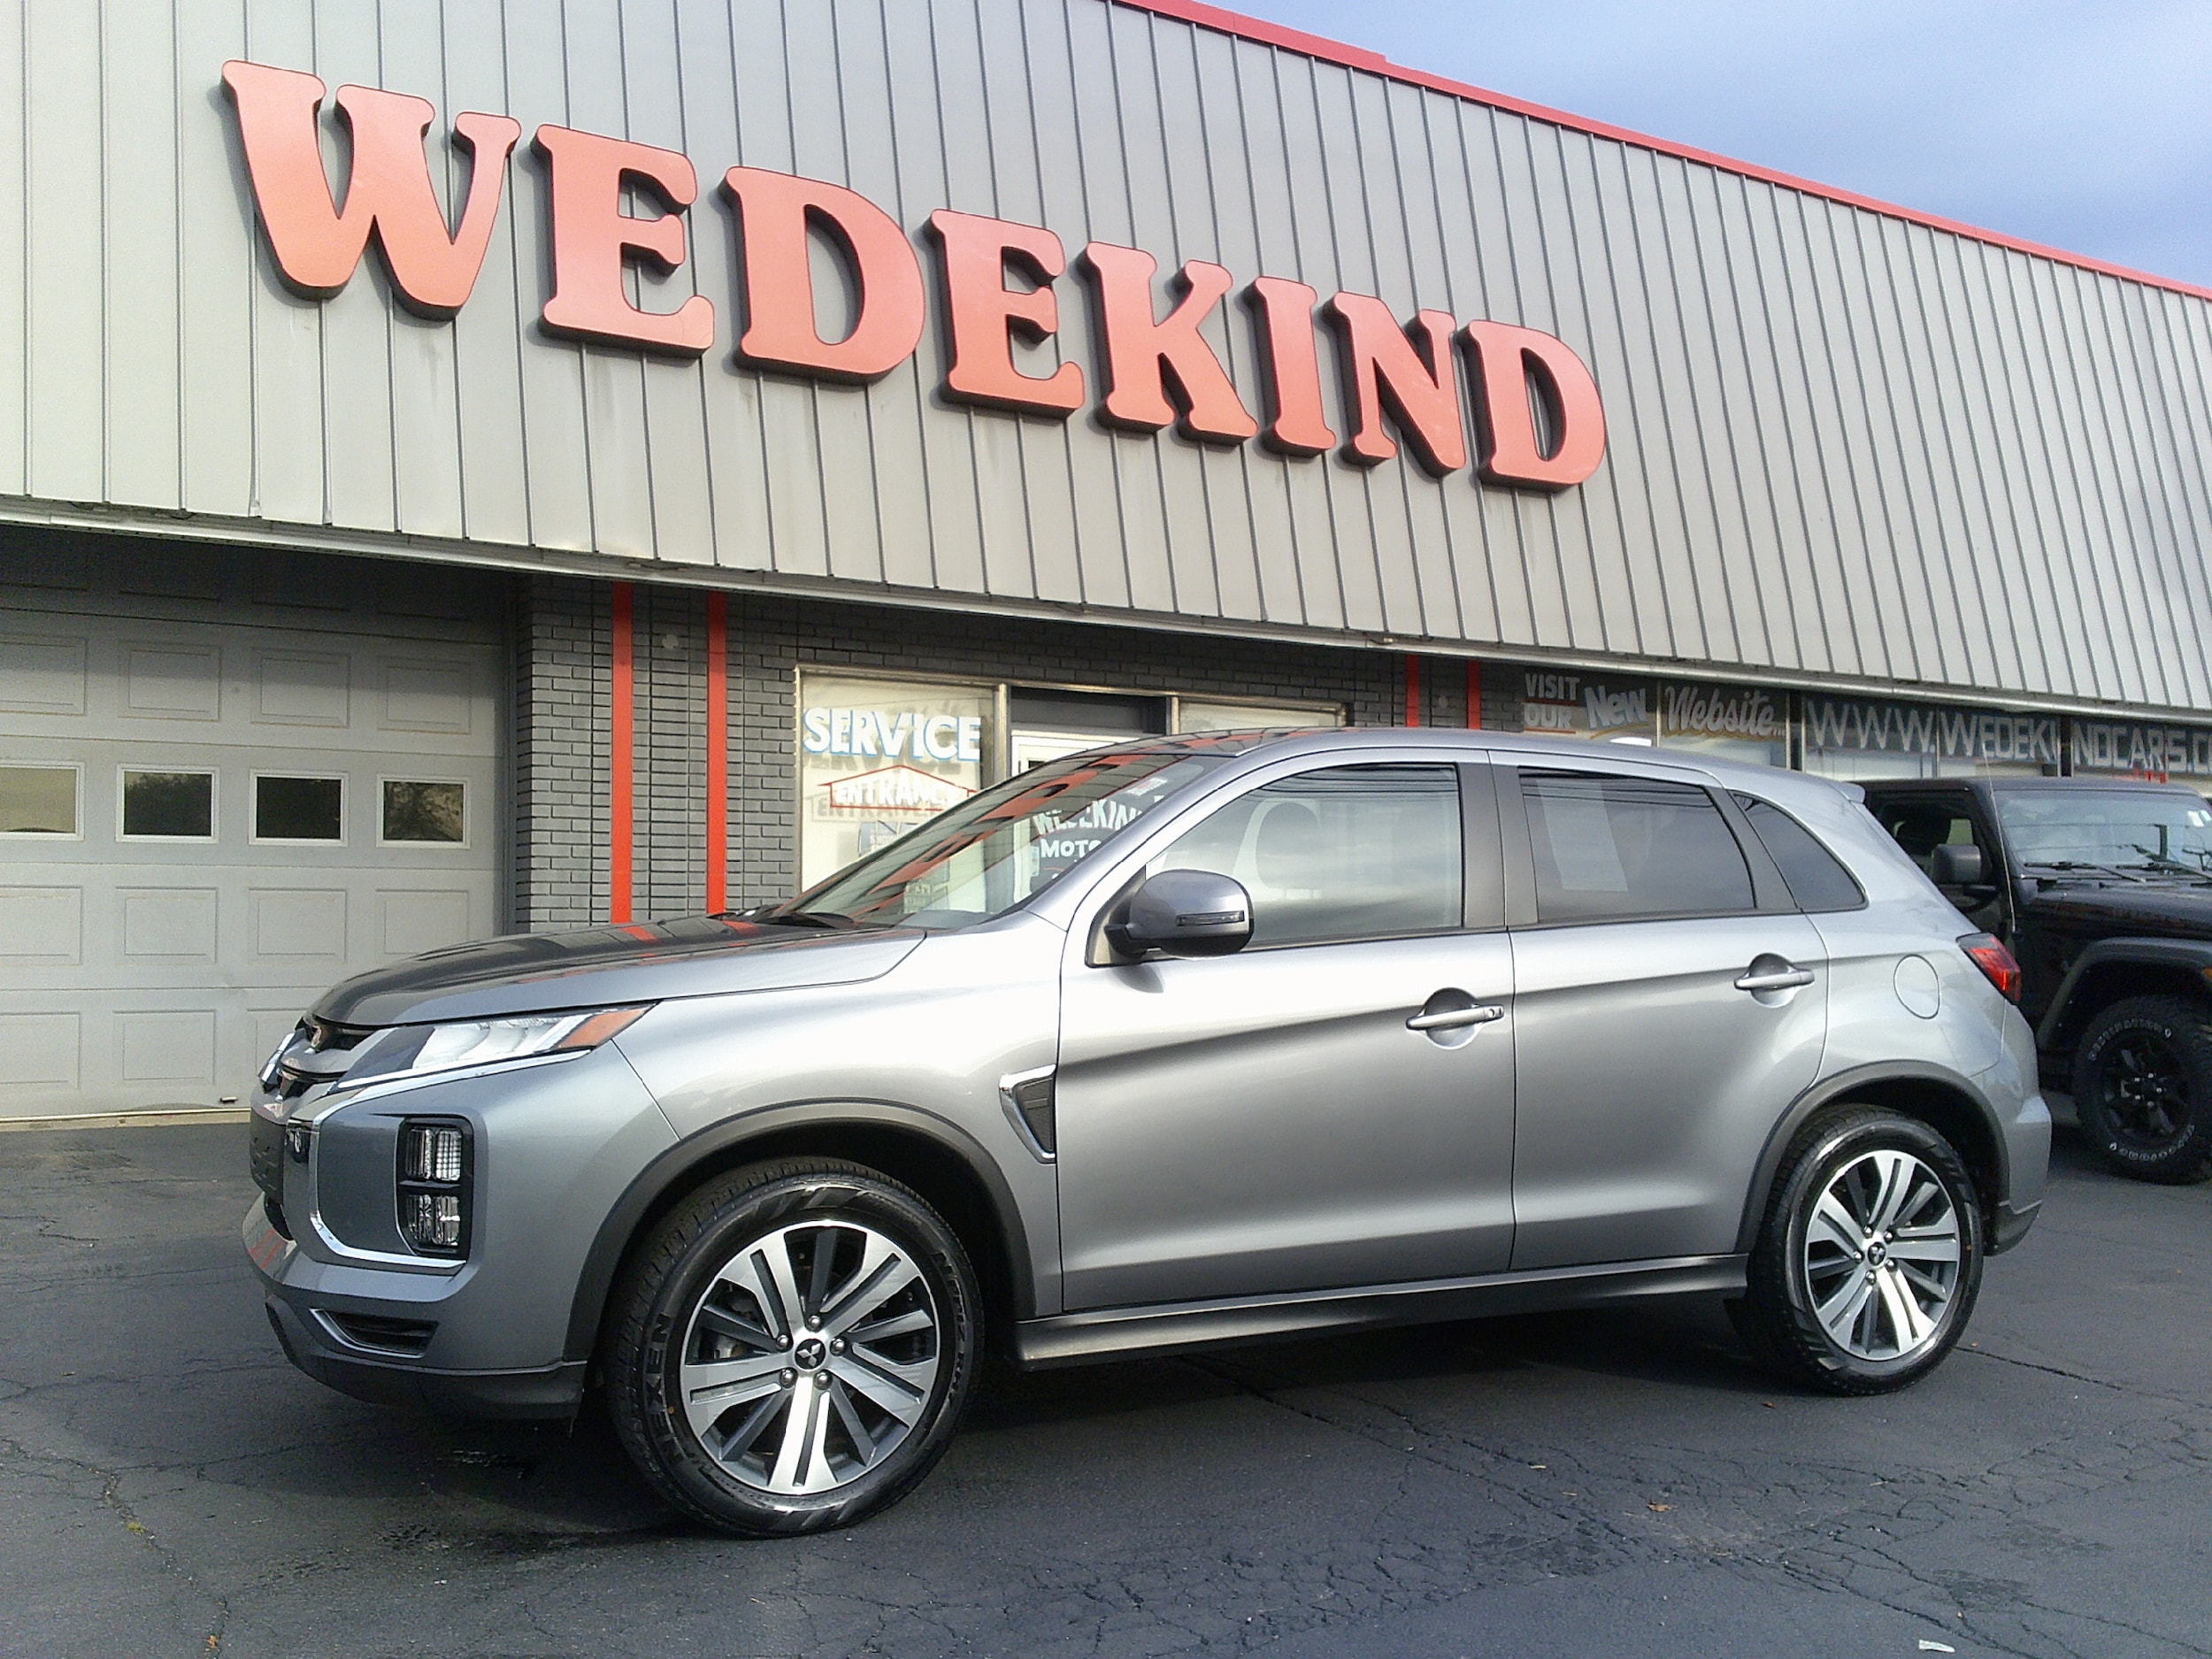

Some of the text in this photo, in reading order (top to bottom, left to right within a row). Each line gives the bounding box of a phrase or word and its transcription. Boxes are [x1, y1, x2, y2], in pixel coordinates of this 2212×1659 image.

[221, 59, 1607, 494] WEDEKIND
[1525, 673, 1580, 701] VISIT
[803, 708, 981, 762] SERVICE
[1525, 703, 1572, 728] OUR
[645, 1314, 685, 1463] NEXEN
